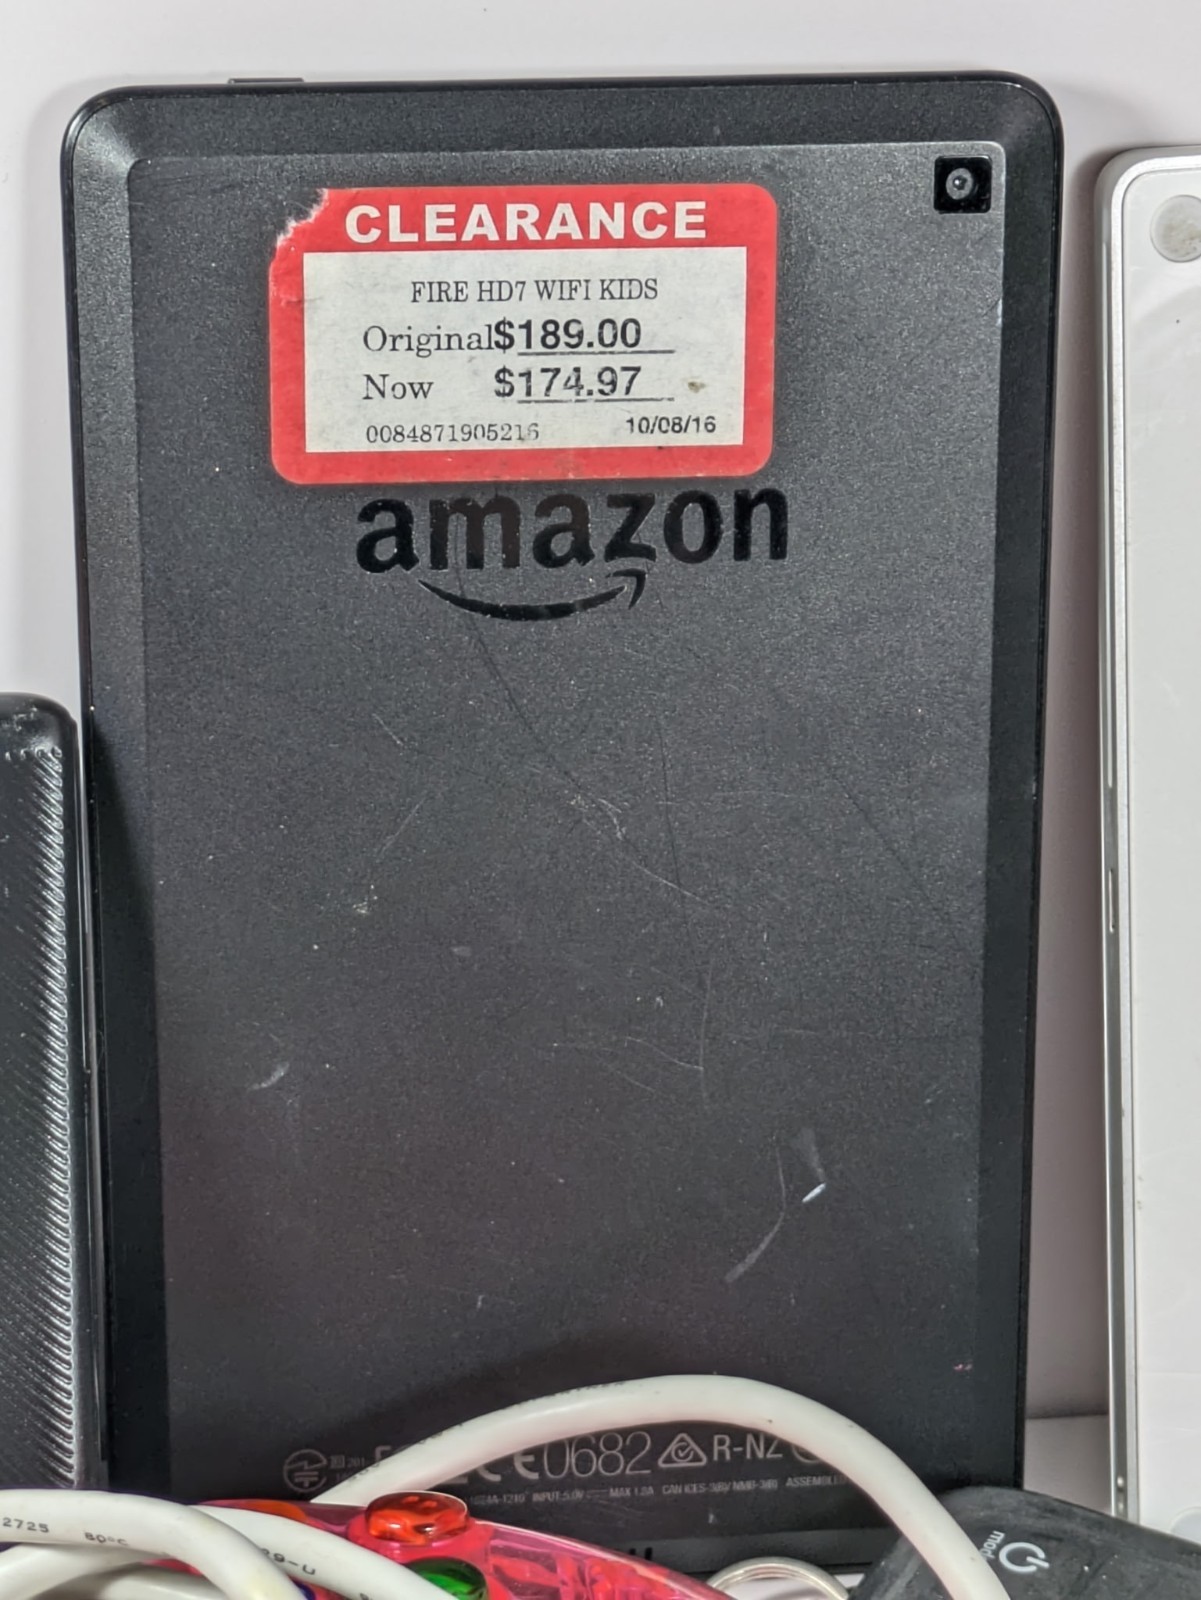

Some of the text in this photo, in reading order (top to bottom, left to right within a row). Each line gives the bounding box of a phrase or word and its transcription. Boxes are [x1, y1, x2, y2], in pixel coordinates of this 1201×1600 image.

[344, 200, 707, 244] CLEARANCE
[411, 277, 659, 303] FIRE HD7 WIFI KIDS
[362, 317, 642, 358] Original $189.00
[362, 365, 642, 400] Now $174.97
[365, 415, 717, 444] 0084871905216 10/08/16
[355, 486, 790, 573] amazon
[2, 1517, 50, 1533] 2725
[979, 1530, 1005, 1561] mod
